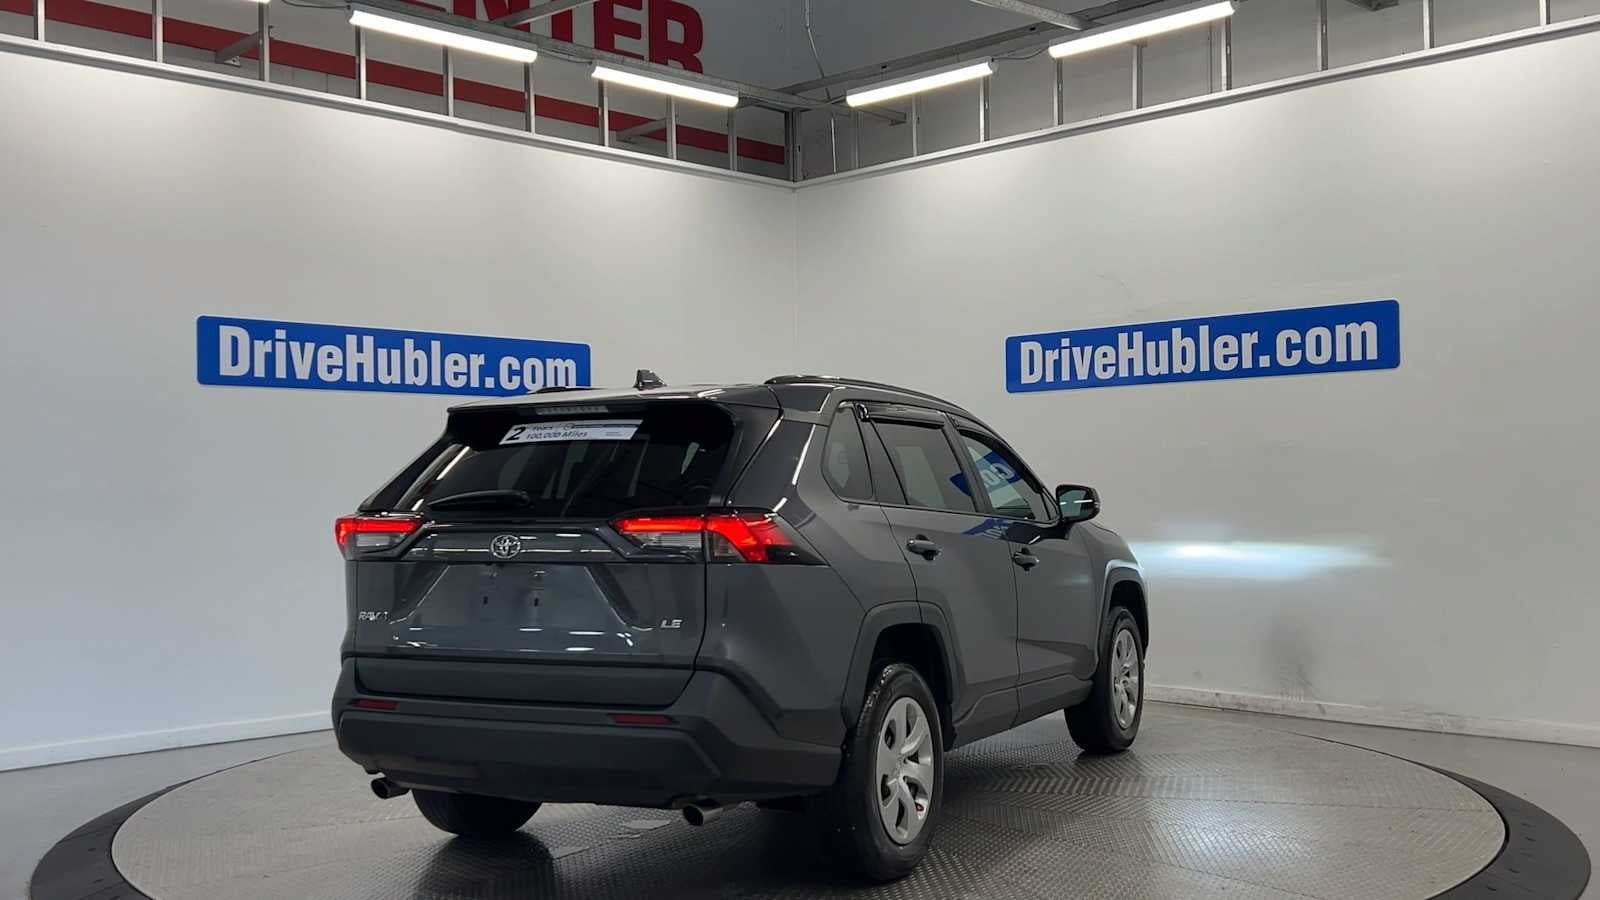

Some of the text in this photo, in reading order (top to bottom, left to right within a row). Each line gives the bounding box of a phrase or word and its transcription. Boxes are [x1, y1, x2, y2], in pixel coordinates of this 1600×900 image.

[219, 325, 577, 391] DriveHubler.com
[1020, 320, 1379, 384] DriveHubler.com
[506, 427, 526, 441] 2
[660, 619, 683, 628] LE
